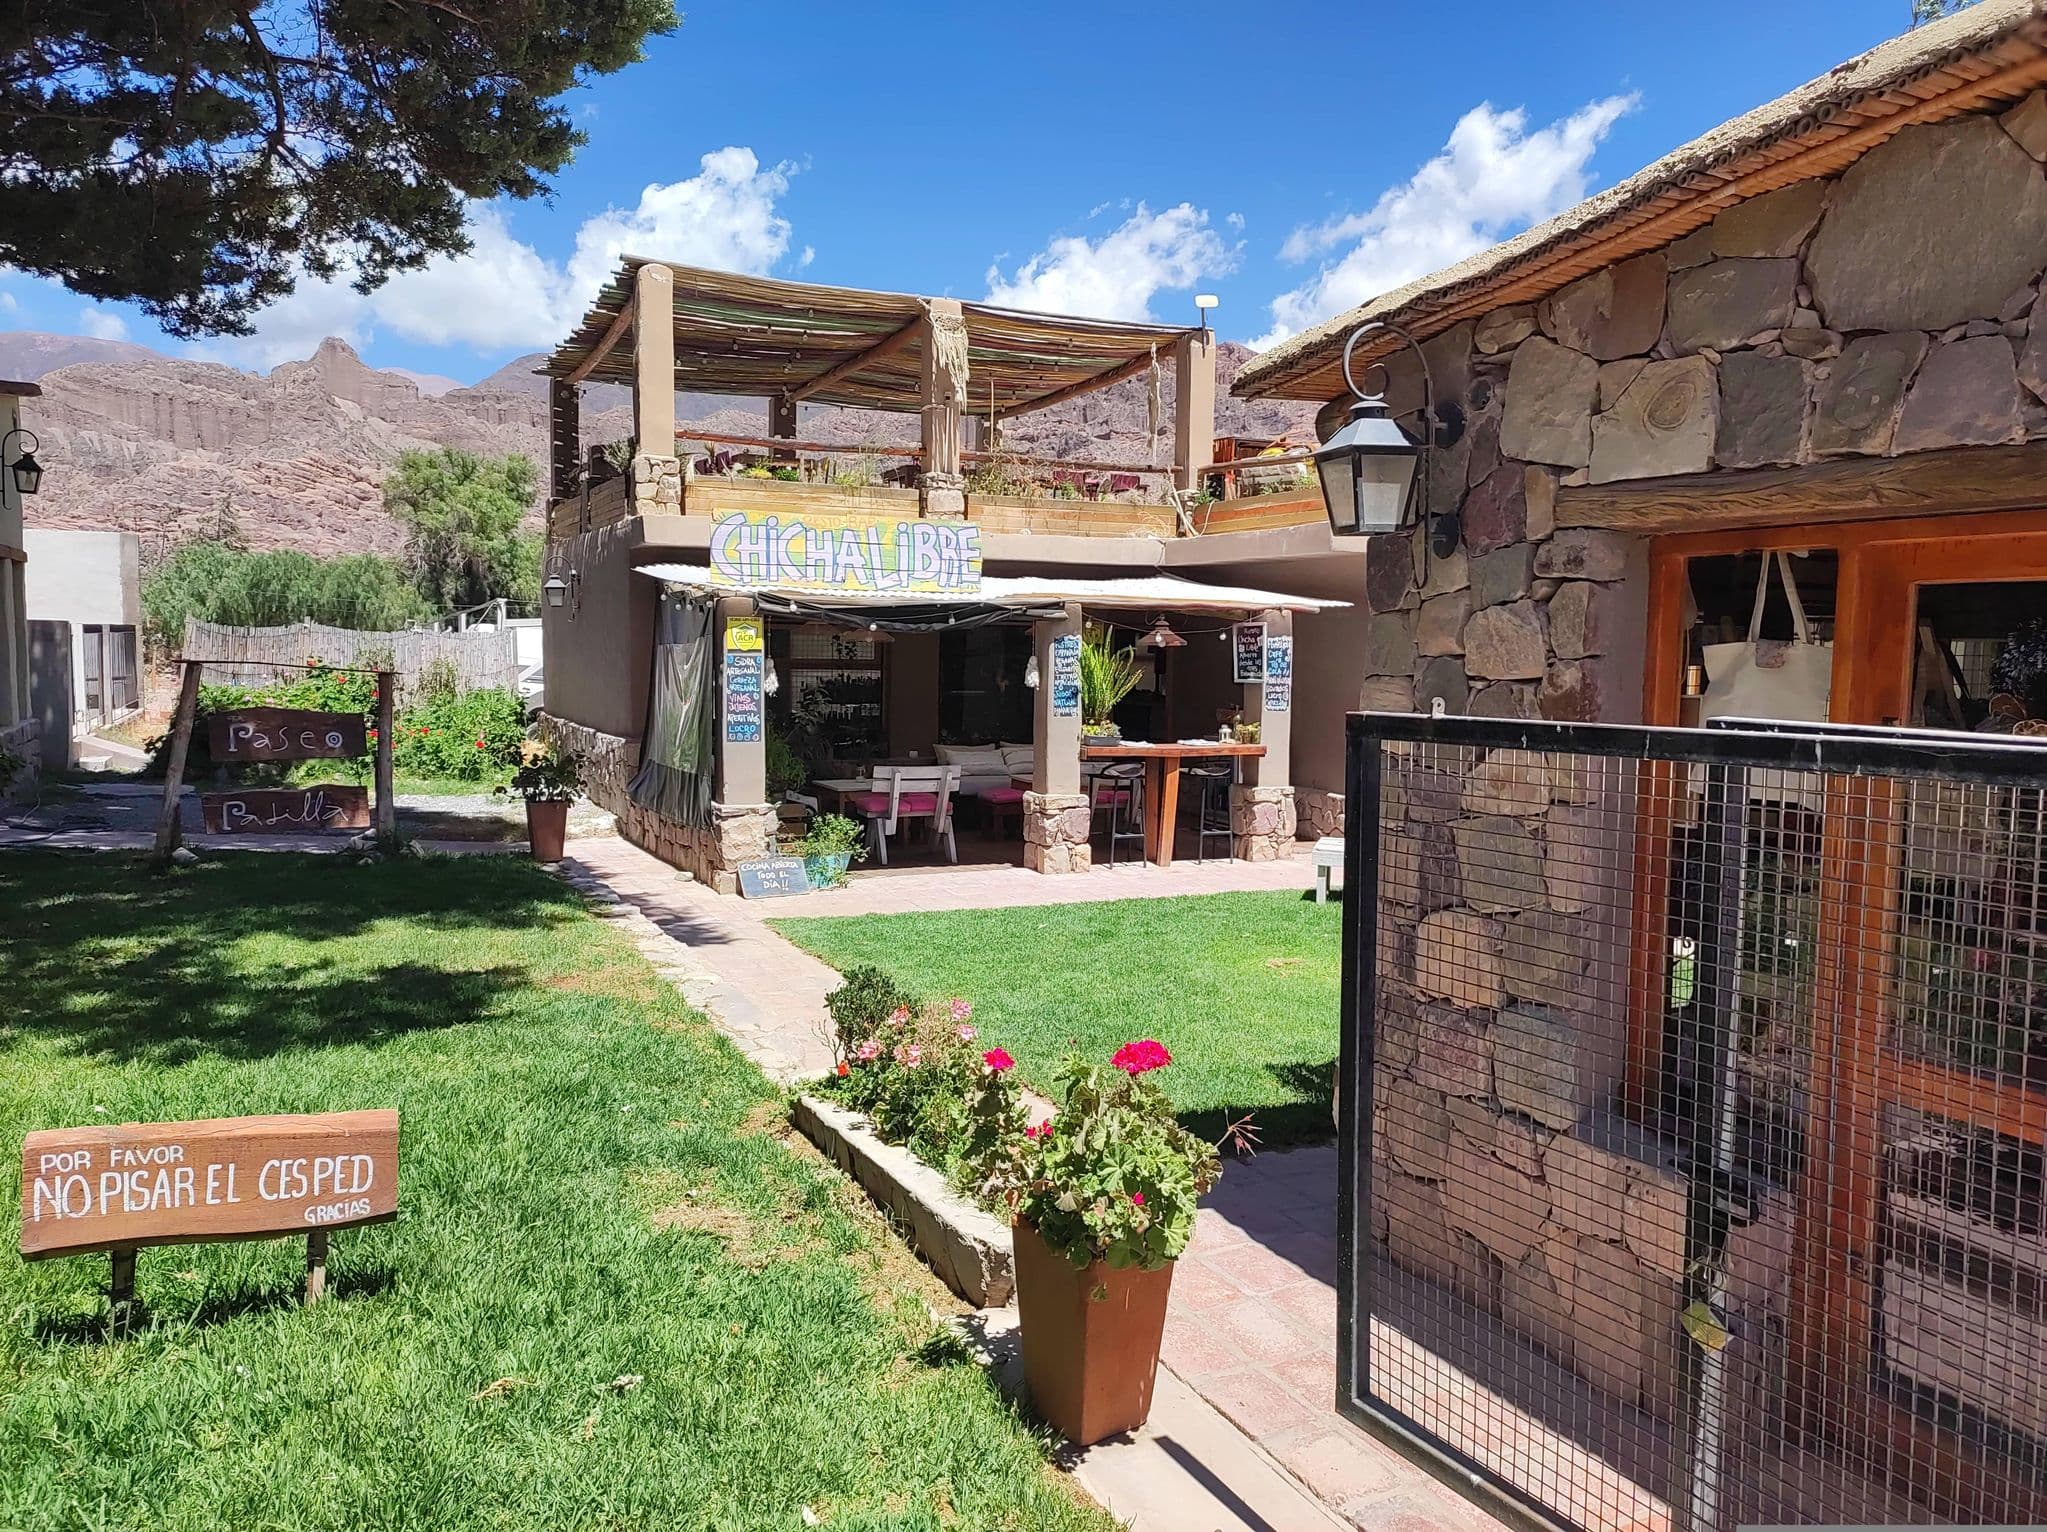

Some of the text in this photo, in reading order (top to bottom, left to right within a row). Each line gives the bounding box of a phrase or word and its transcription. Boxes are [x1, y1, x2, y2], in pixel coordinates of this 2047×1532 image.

[227, 723, 343, 752] Paseo
[729, 724, 757, 734] LOCRO
[222, 791, 349, 831] Padilla
[40, 1145, 184, 1174] POR FAVOR
[33, 1154, 374, 1222] NO PISAR EL CESPED
